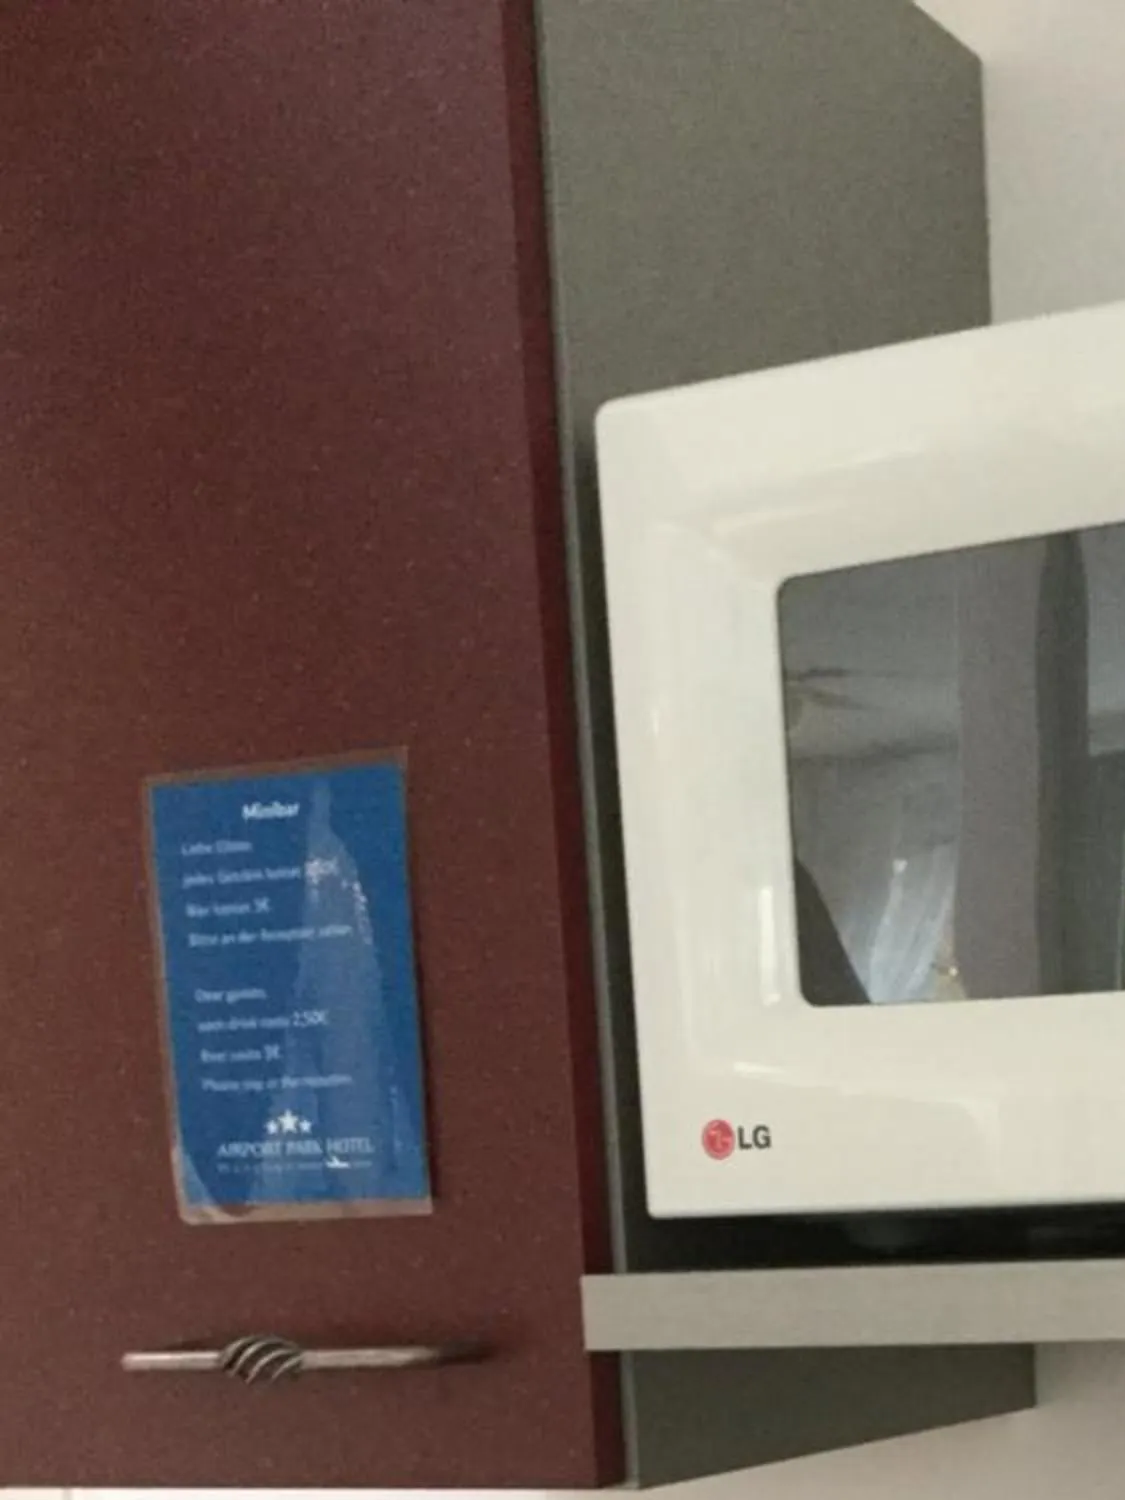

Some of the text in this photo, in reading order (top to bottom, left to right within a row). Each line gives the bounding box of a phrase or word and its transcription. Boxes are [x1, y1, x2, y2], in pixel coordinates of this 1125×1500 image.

[241, 800, 300, 822] Minibar
[216, 1140, 283, 1159] AIRPORT
[325, 1136, 375, 1154] HOTEL
[737, 1124, 773, 1150] LG
